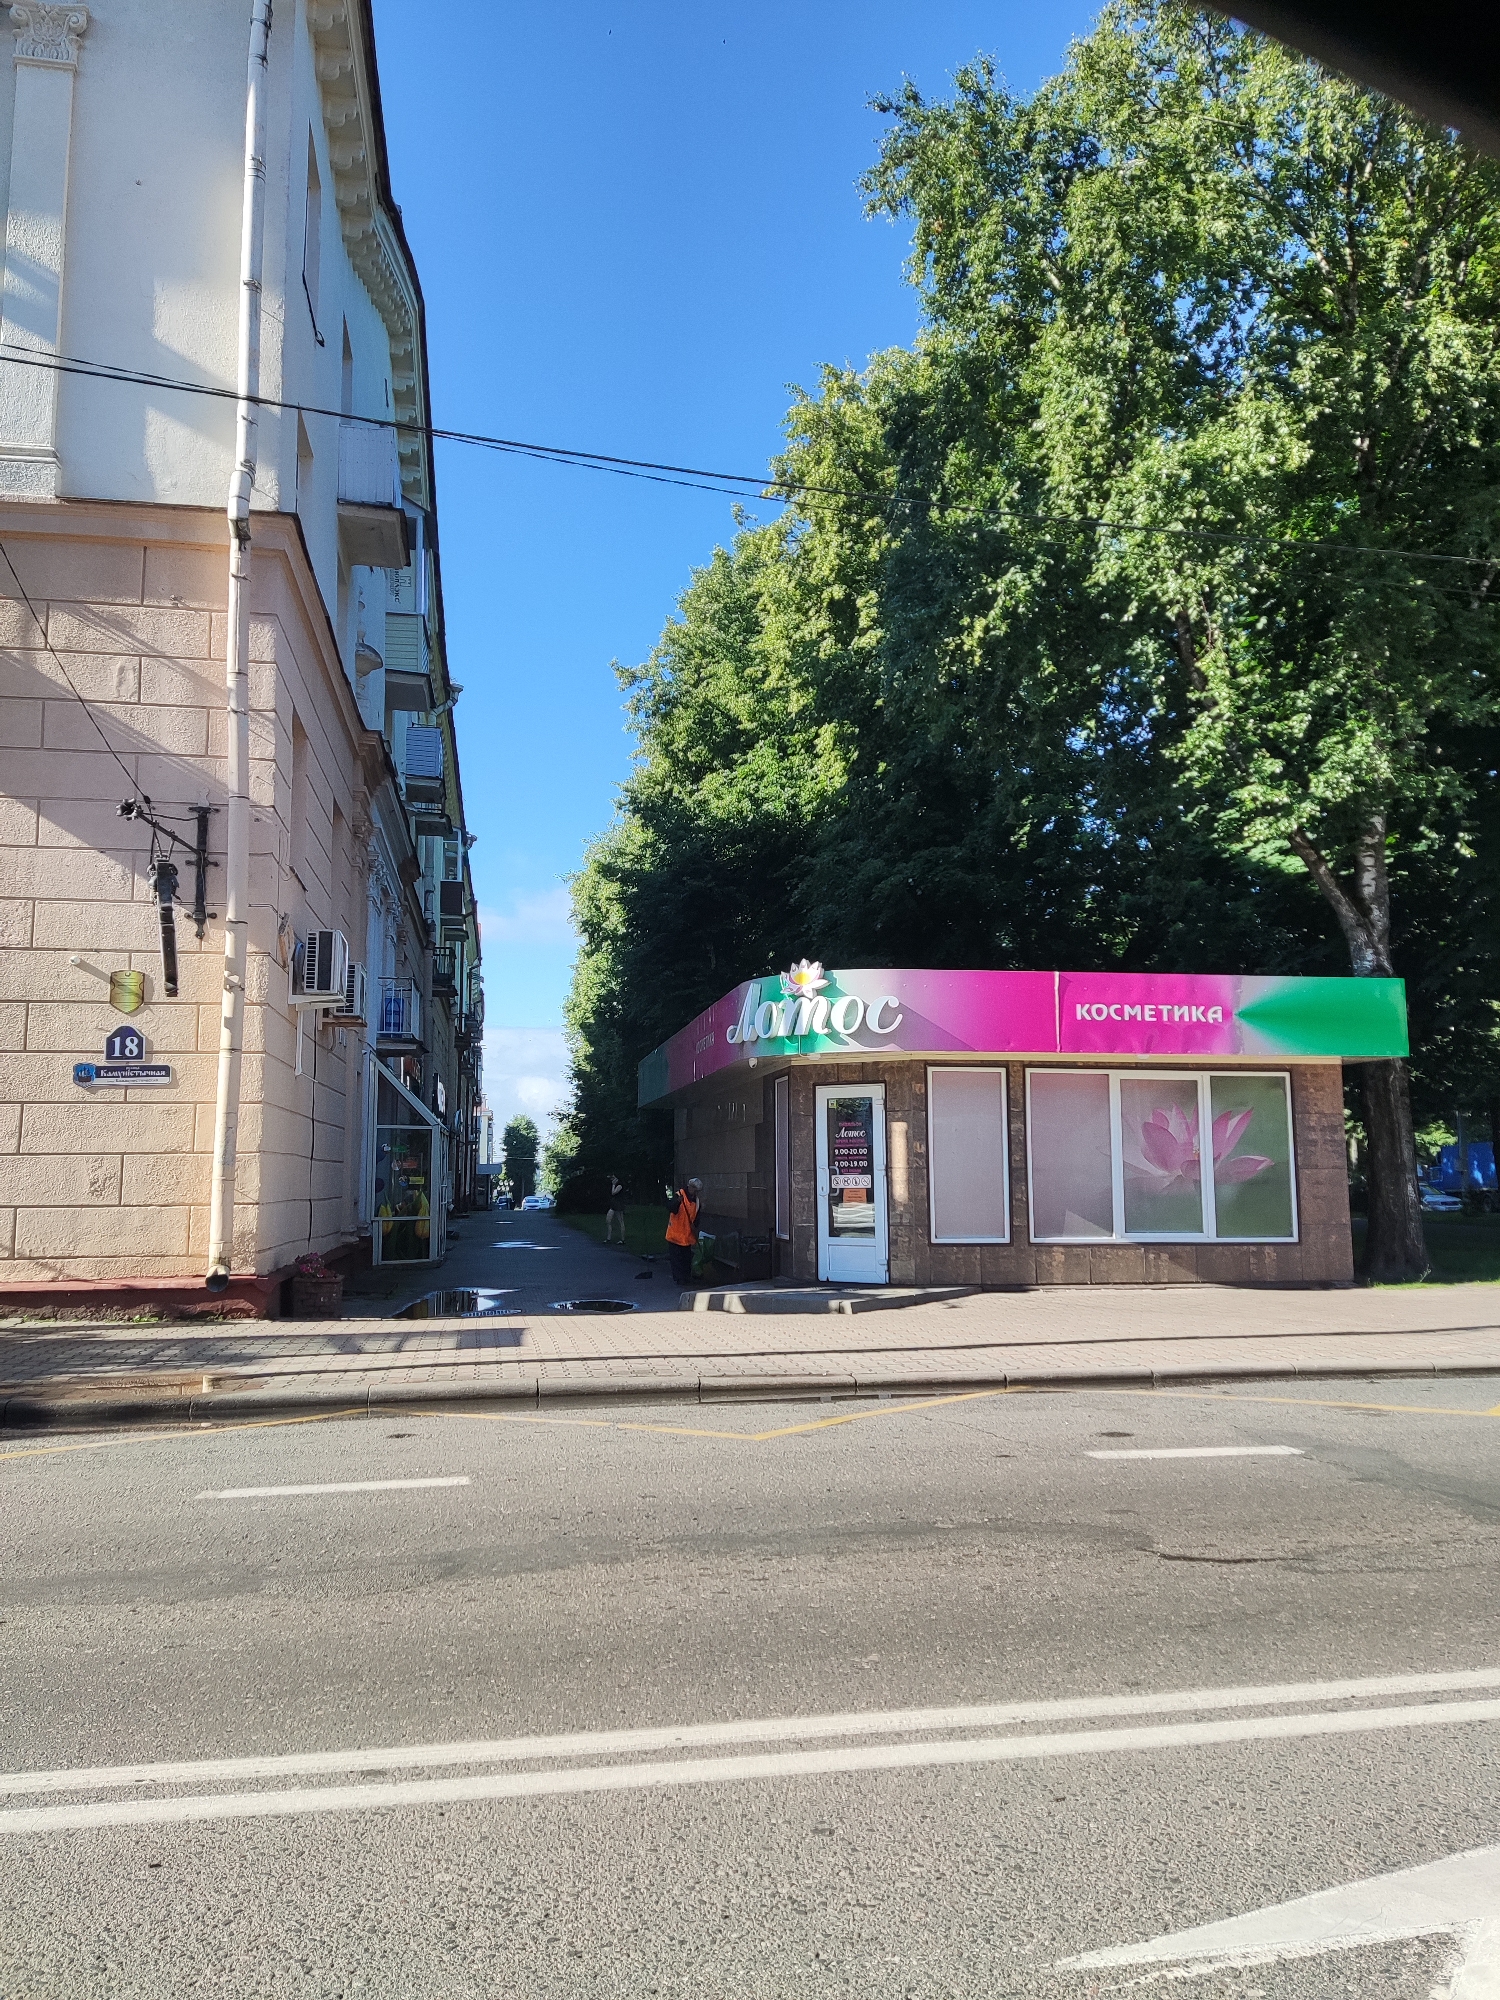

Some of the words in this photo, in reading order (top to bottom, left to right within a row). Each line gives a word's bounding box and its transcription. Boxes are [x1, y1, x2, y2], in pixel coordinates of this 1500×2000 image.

[725, 982, 903, 1044] Лотос
[1075, 1003, 1223, 1023] КОСМЕТИКА
[111, 1036, 139, 1057] 18
[835, 1127, 866, 1138] Лотос
